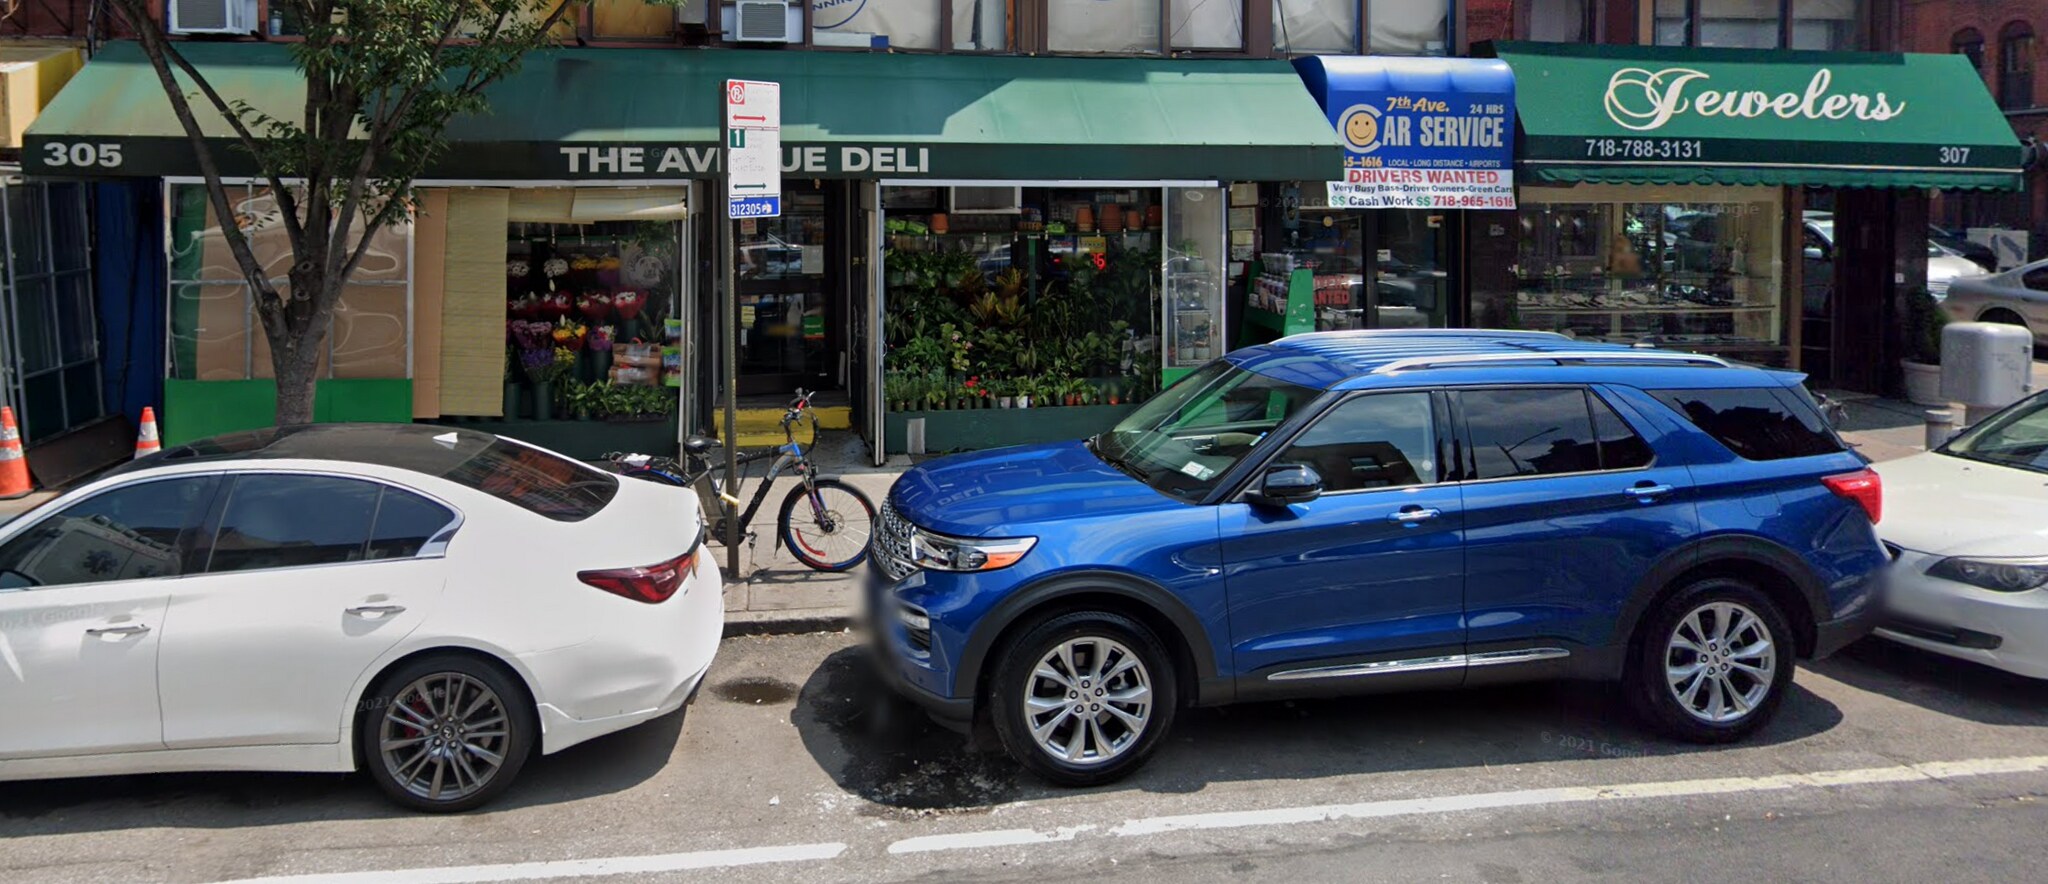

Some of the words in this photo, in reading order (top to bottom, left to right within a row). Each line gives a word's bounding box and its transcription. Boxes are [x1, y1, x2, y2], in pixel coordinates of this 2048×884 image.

[1386, 97, 1411, 113] 7th
[1412, 98, 1449, 113] Ave.
[1603, 67, 1906, 131] Jewelers
[1470, 104, 1482, 115] 24
[1486, 104, 1504, 115] HRS
[1419, 115, 1504, 148] SERVICE
[43, 141, 123, 168] 305
[1585, 138, 1702, 159] 718-788-3131
[1939, 146, 1971, 164] 307
[560, 147, 645, 173] THE
[656, 147, 827, 173] AVUE
[841, 147, 929, 173] DELI
[1388, 159, 1409, 167] LOCAL
[1413, 159, 1432, 167] LONG
[1433, 159, 1464, 168] DISTANCE
[1469, 160, 1501, 168] AIRPORTS
[1349, 169, 1422, 184] DRIVERS
[1426, 170, 1499, 184] WANTED
[1333, 183, 1353, 193] Very
[1354, 184, 1376, 194] Busy
[1377, 184, 1430, 193] Base-Driver
[1431, 185, 1493, 193] Owners-Green
[1331, 195, 1346, 206] $$
[1349, 195, 1379, 206] Cash
[1382, 196, 1414, 206] Work
[1416, 195, 1431, 207] $$
[1433, 195, 1513, 207] 718-965-1616
[731, 204, 760, 216] 312305
